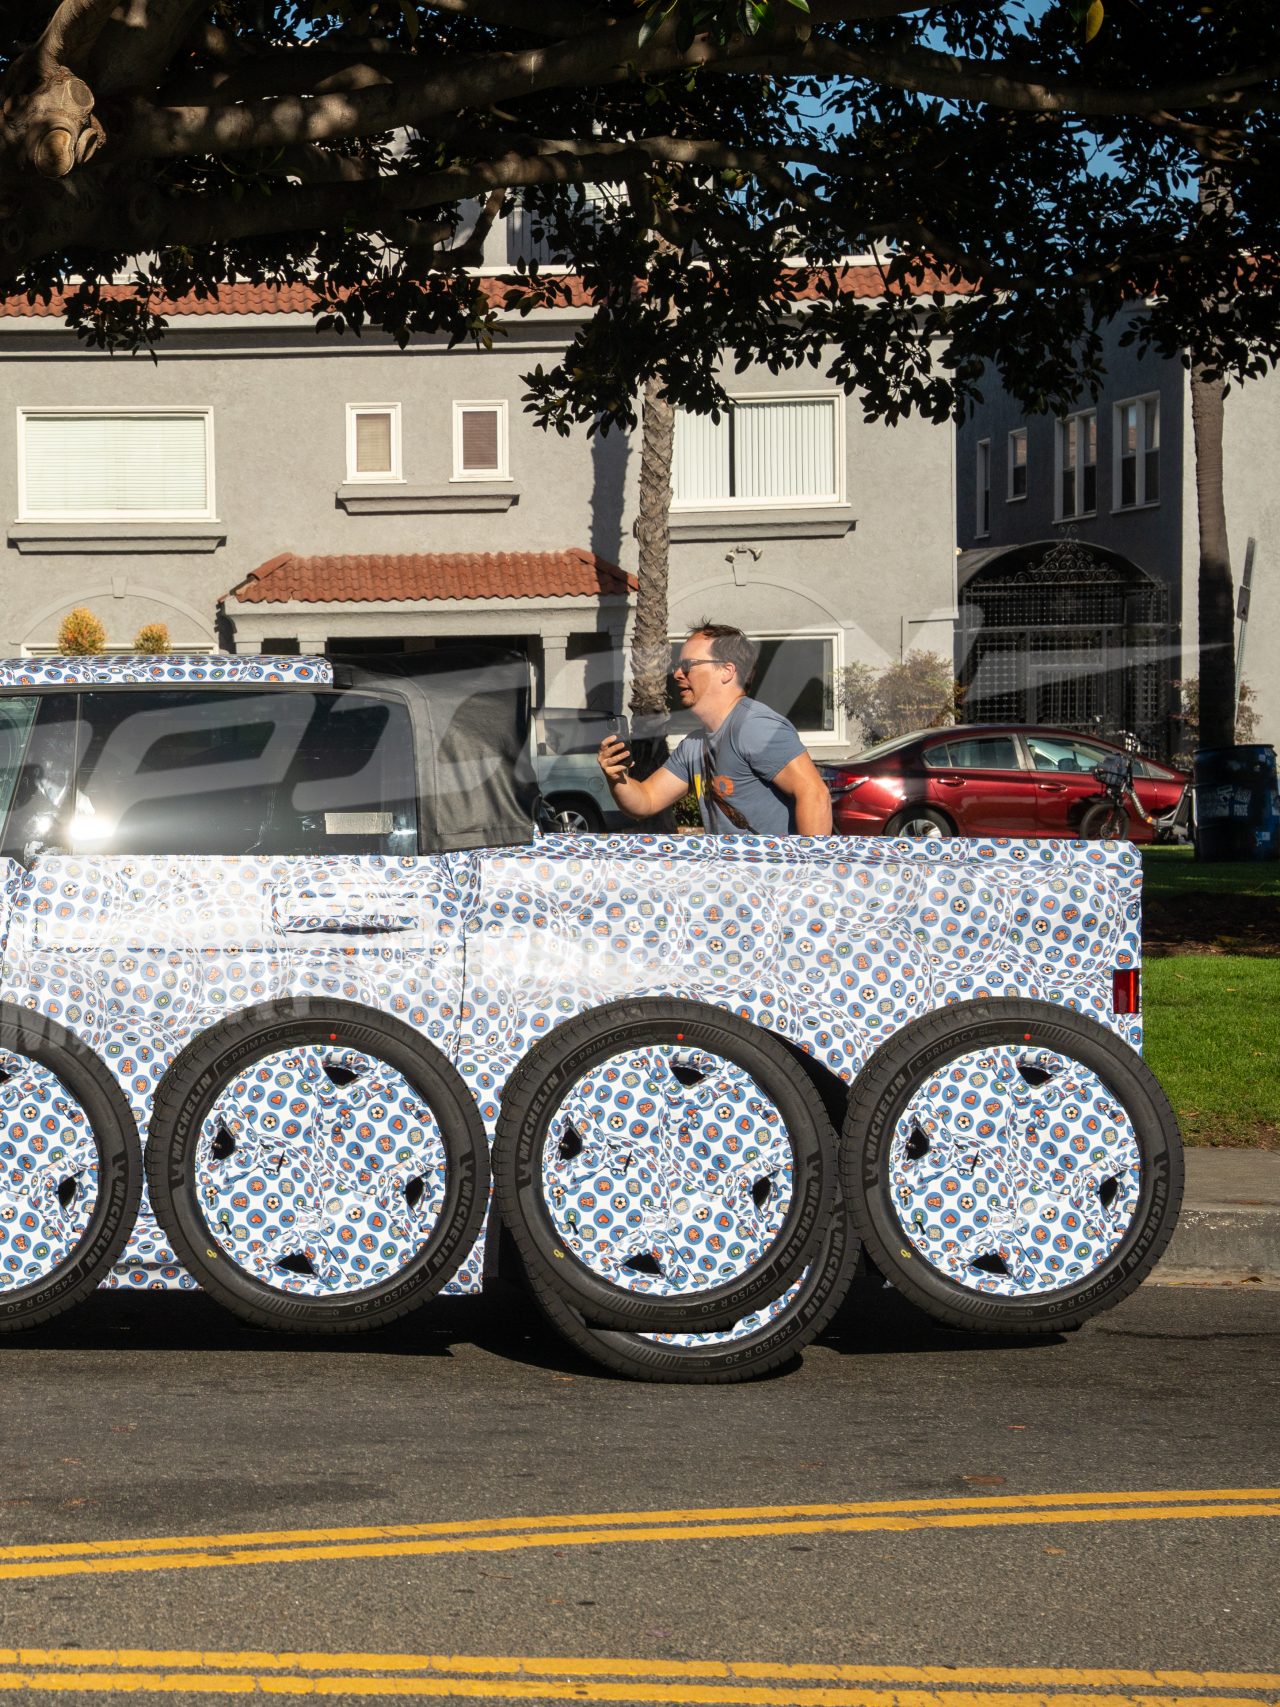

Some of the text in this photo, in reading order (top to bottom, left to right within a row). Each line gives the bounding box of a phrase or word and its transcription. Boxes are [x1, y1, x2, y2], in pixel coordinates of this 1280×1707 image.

[175, 1073, 213, 1162] MICHELIN
[522, 1073, 560, 1162] MICHELIN
[869, 1073, 907, 1162] MICHELIN
[84, 1180, 127, 1269] MICHELIN
[431, 1180, 474, 1269] MICHELIN
[778, 1180, 821, 1269] MICHELIN
[1125, 1180, 1168, 1269] MICHELIN
[37, 1273, 77, 1302] 245/50
[384, 1273, 424, 1302] 245/50
[731, 1273, 771, 1302] 245/50
[803, 1231, 845, 1319] MICHELIN
[1078, 1273, 1118, 1302] 245/50
[7, 1303, 23, 1313] 20
[354, 1303, 370, 1313] 20
[701, 1303, 717, 1313] 20
[1048, 1303, 1064, 1313] 20
[755, 1324, 793, 1353] 245/50
[725, 1354, 740, 1364] 20
